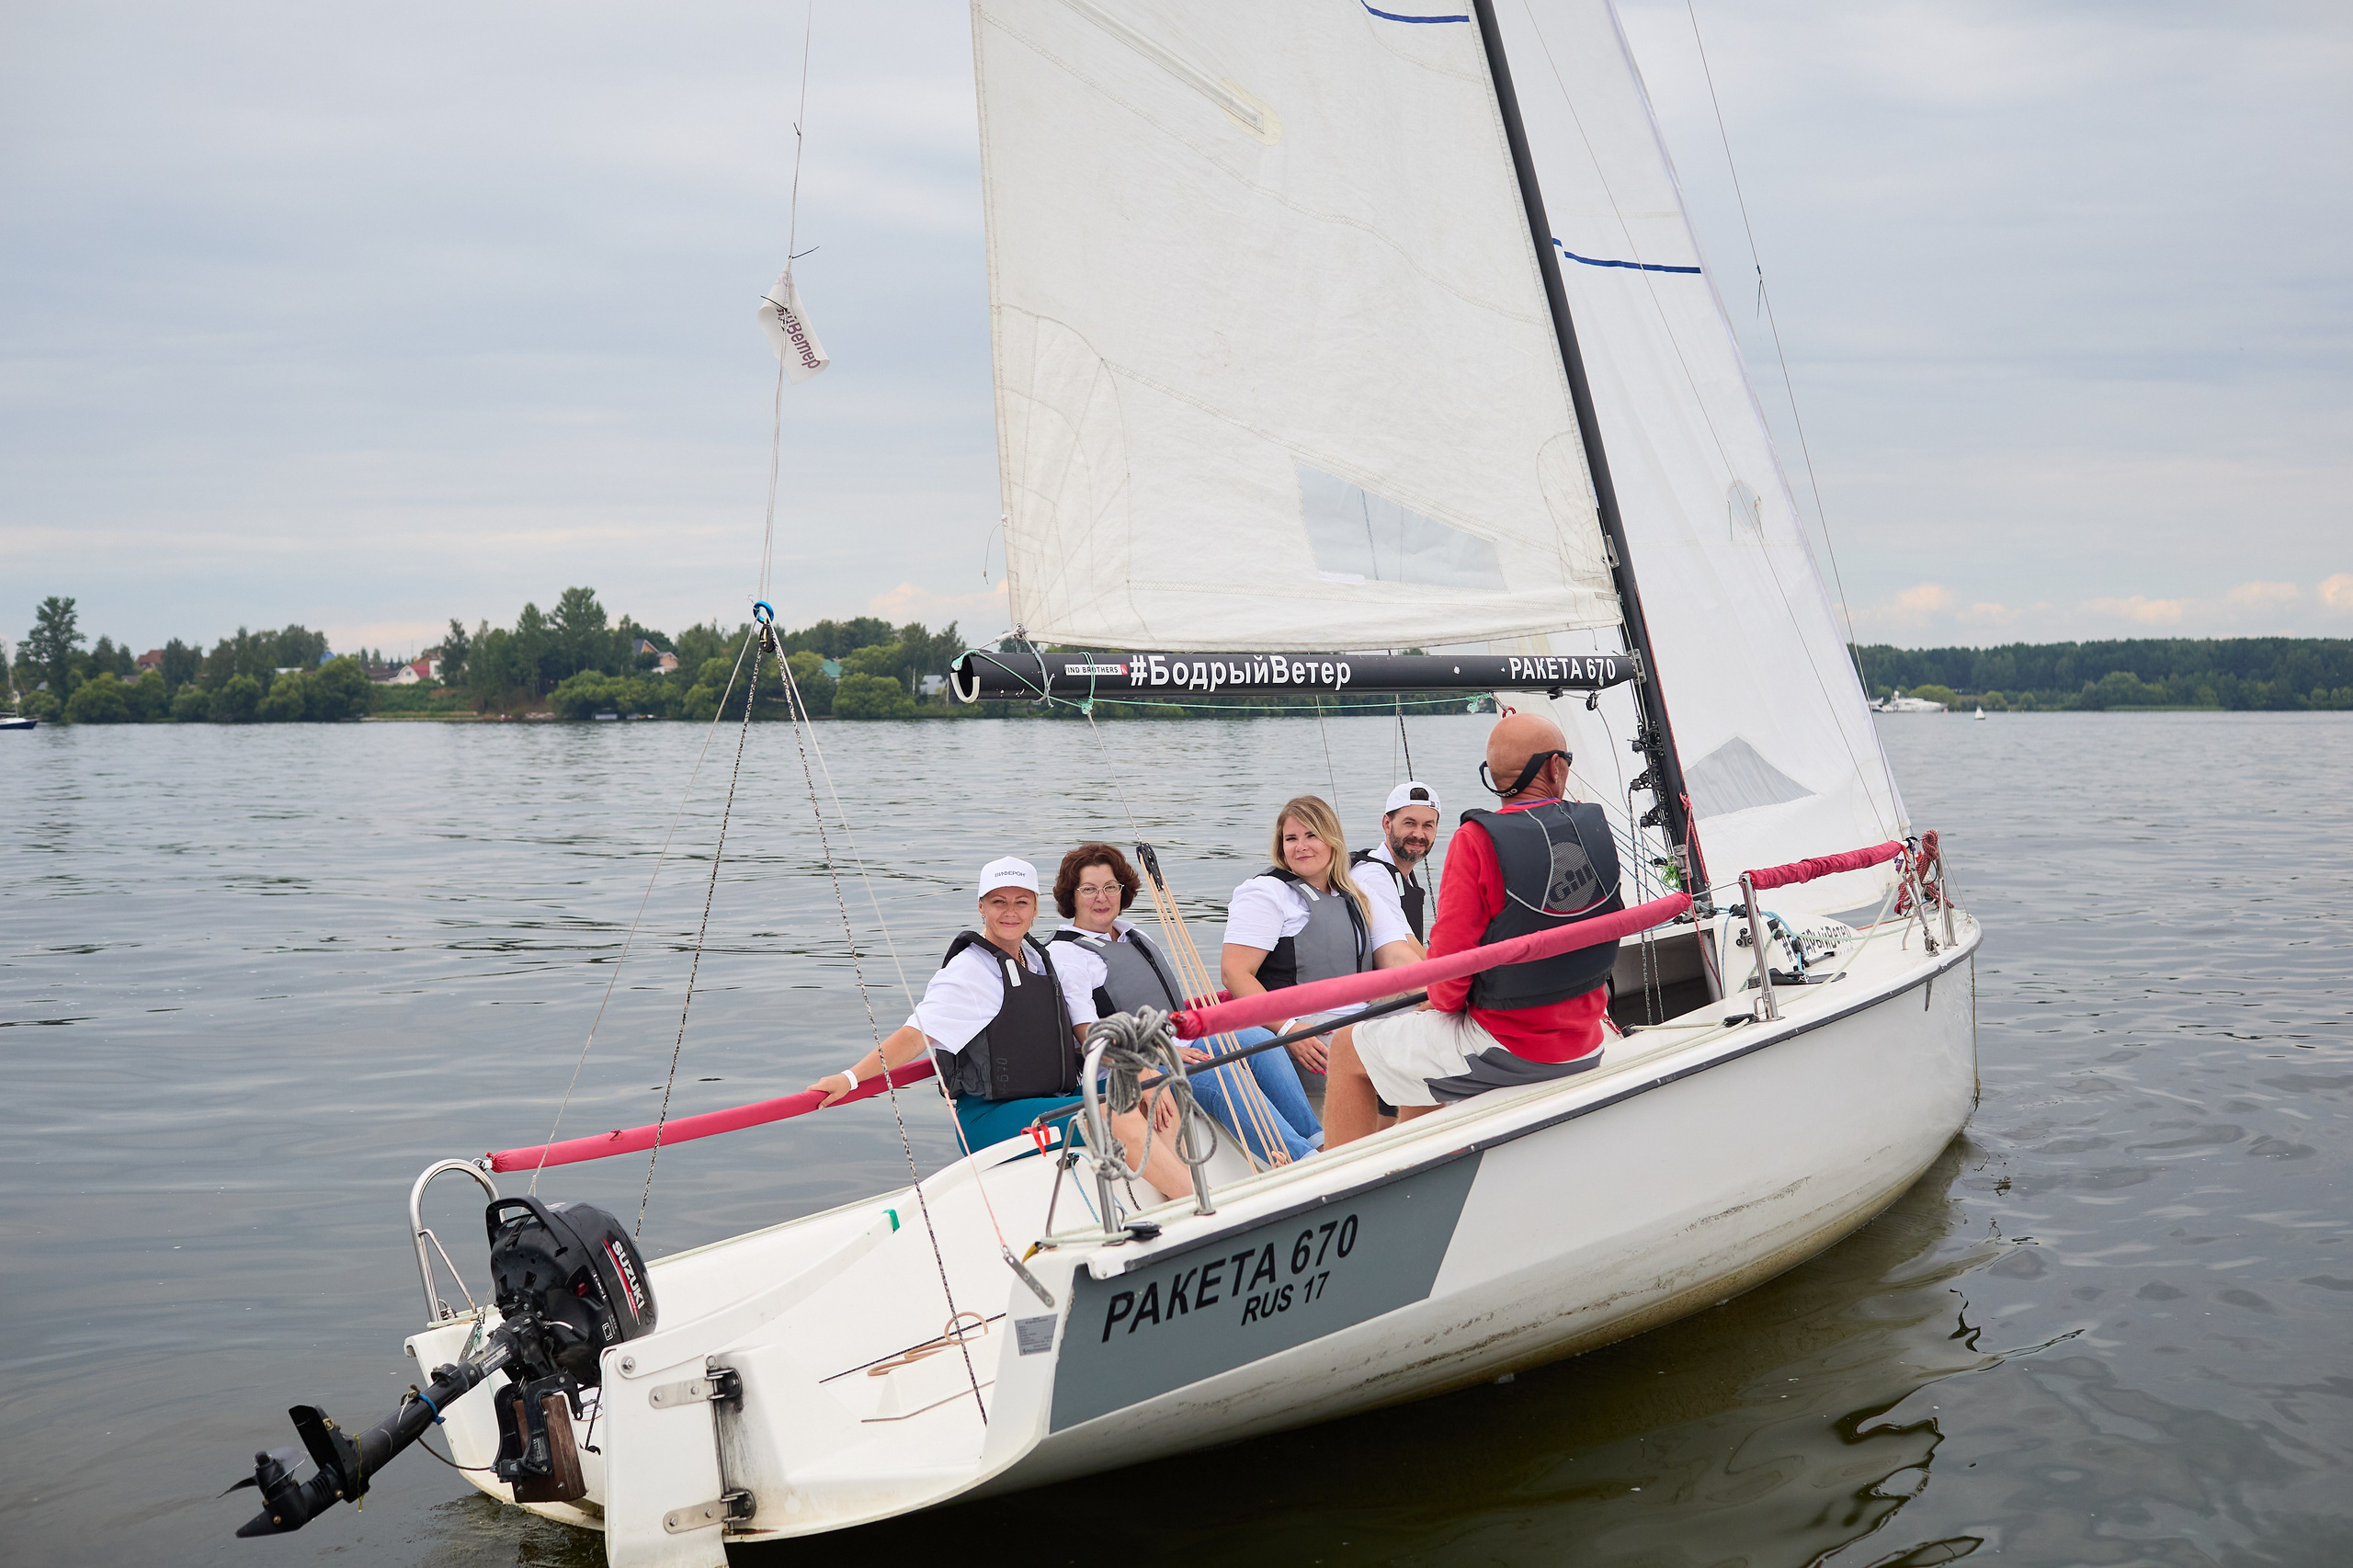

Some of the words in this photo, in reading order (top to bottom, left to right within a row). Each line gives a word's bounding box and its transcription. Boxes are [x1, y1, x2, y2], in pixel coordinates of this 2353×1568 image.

[1064, 665, 1080, 674] IND
[1130, 654, 1351, 692] #БодрыйВетер
[1508, 657, 1583, 680] РАКЕТА
[1586, 657, 1616, 681] 670
[1549, 863, 1593, 903] Gill
[611, 1240, 645, 1310] SUZUKI
[1102, 1243, 1277, 1344] РАКЕТА
[1290, 1213, 1358, 1274] 670
[1241, 1283, 1294, 1326] RUS
[1303, 1270, 1330, 1306] 17
